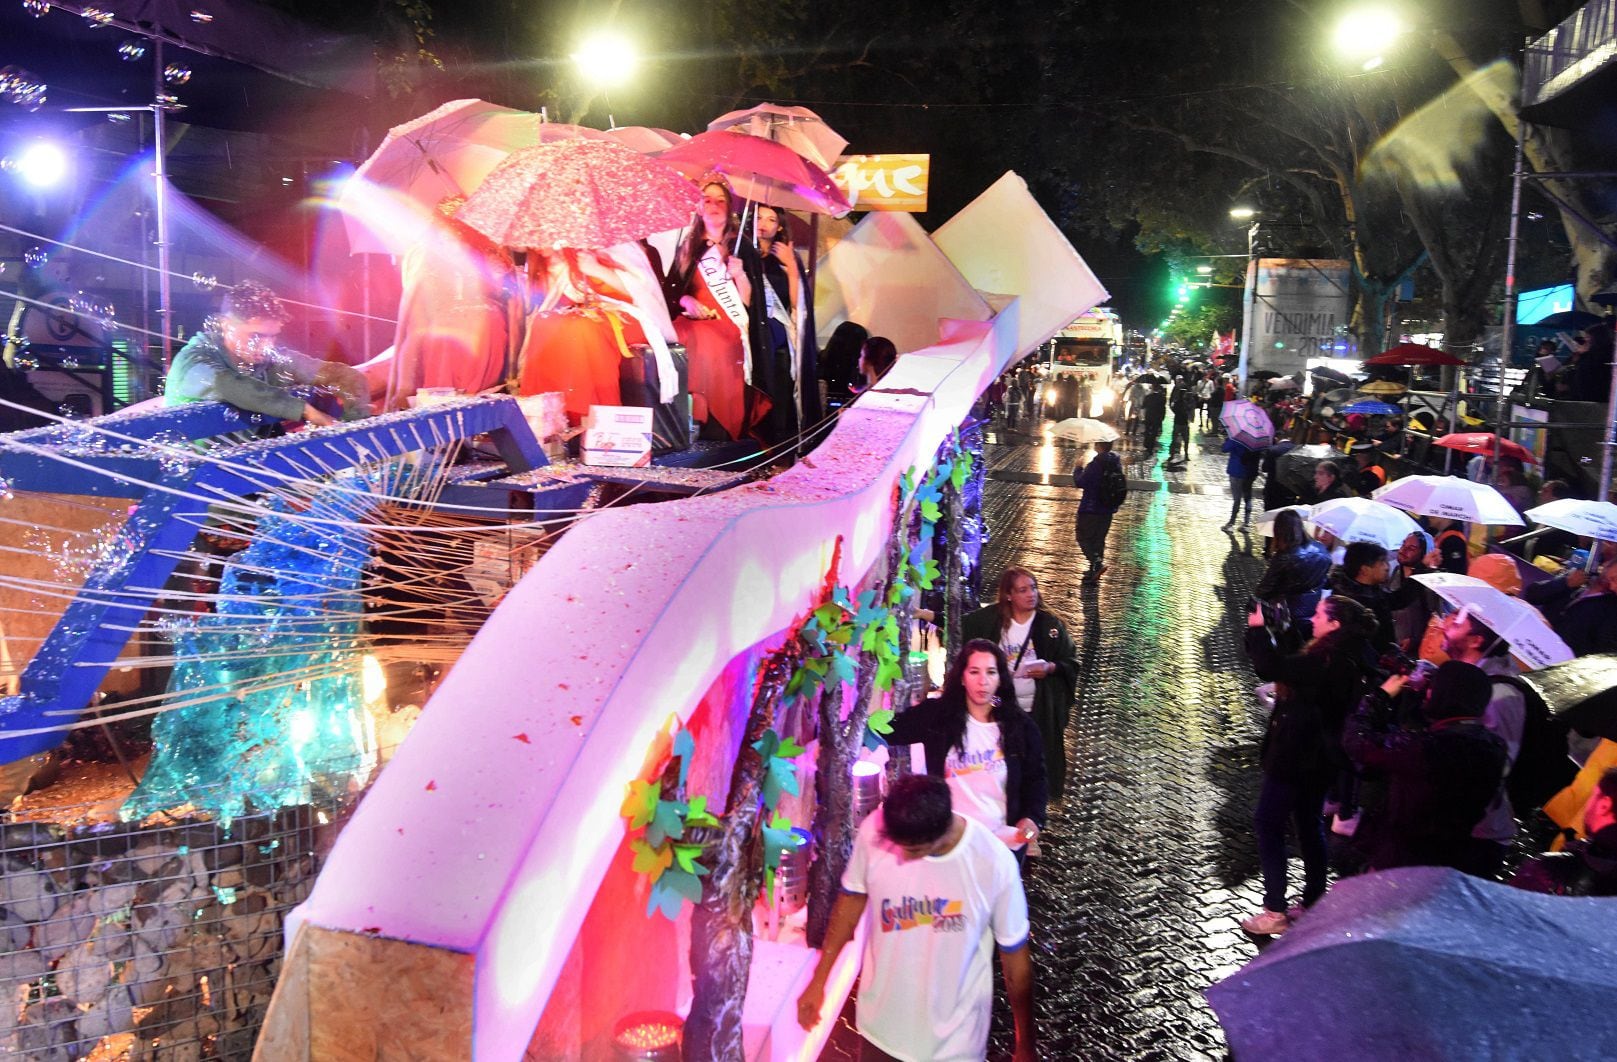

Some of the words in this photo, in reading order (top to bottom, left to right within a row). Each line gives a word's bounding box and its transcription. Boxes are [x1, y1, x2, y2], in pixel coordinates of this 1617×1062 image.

[699, 256, 719, 277] La
[1264, 312, 1336, 336] VENDIMIA
[880, 895, 948, 925] Cultura
